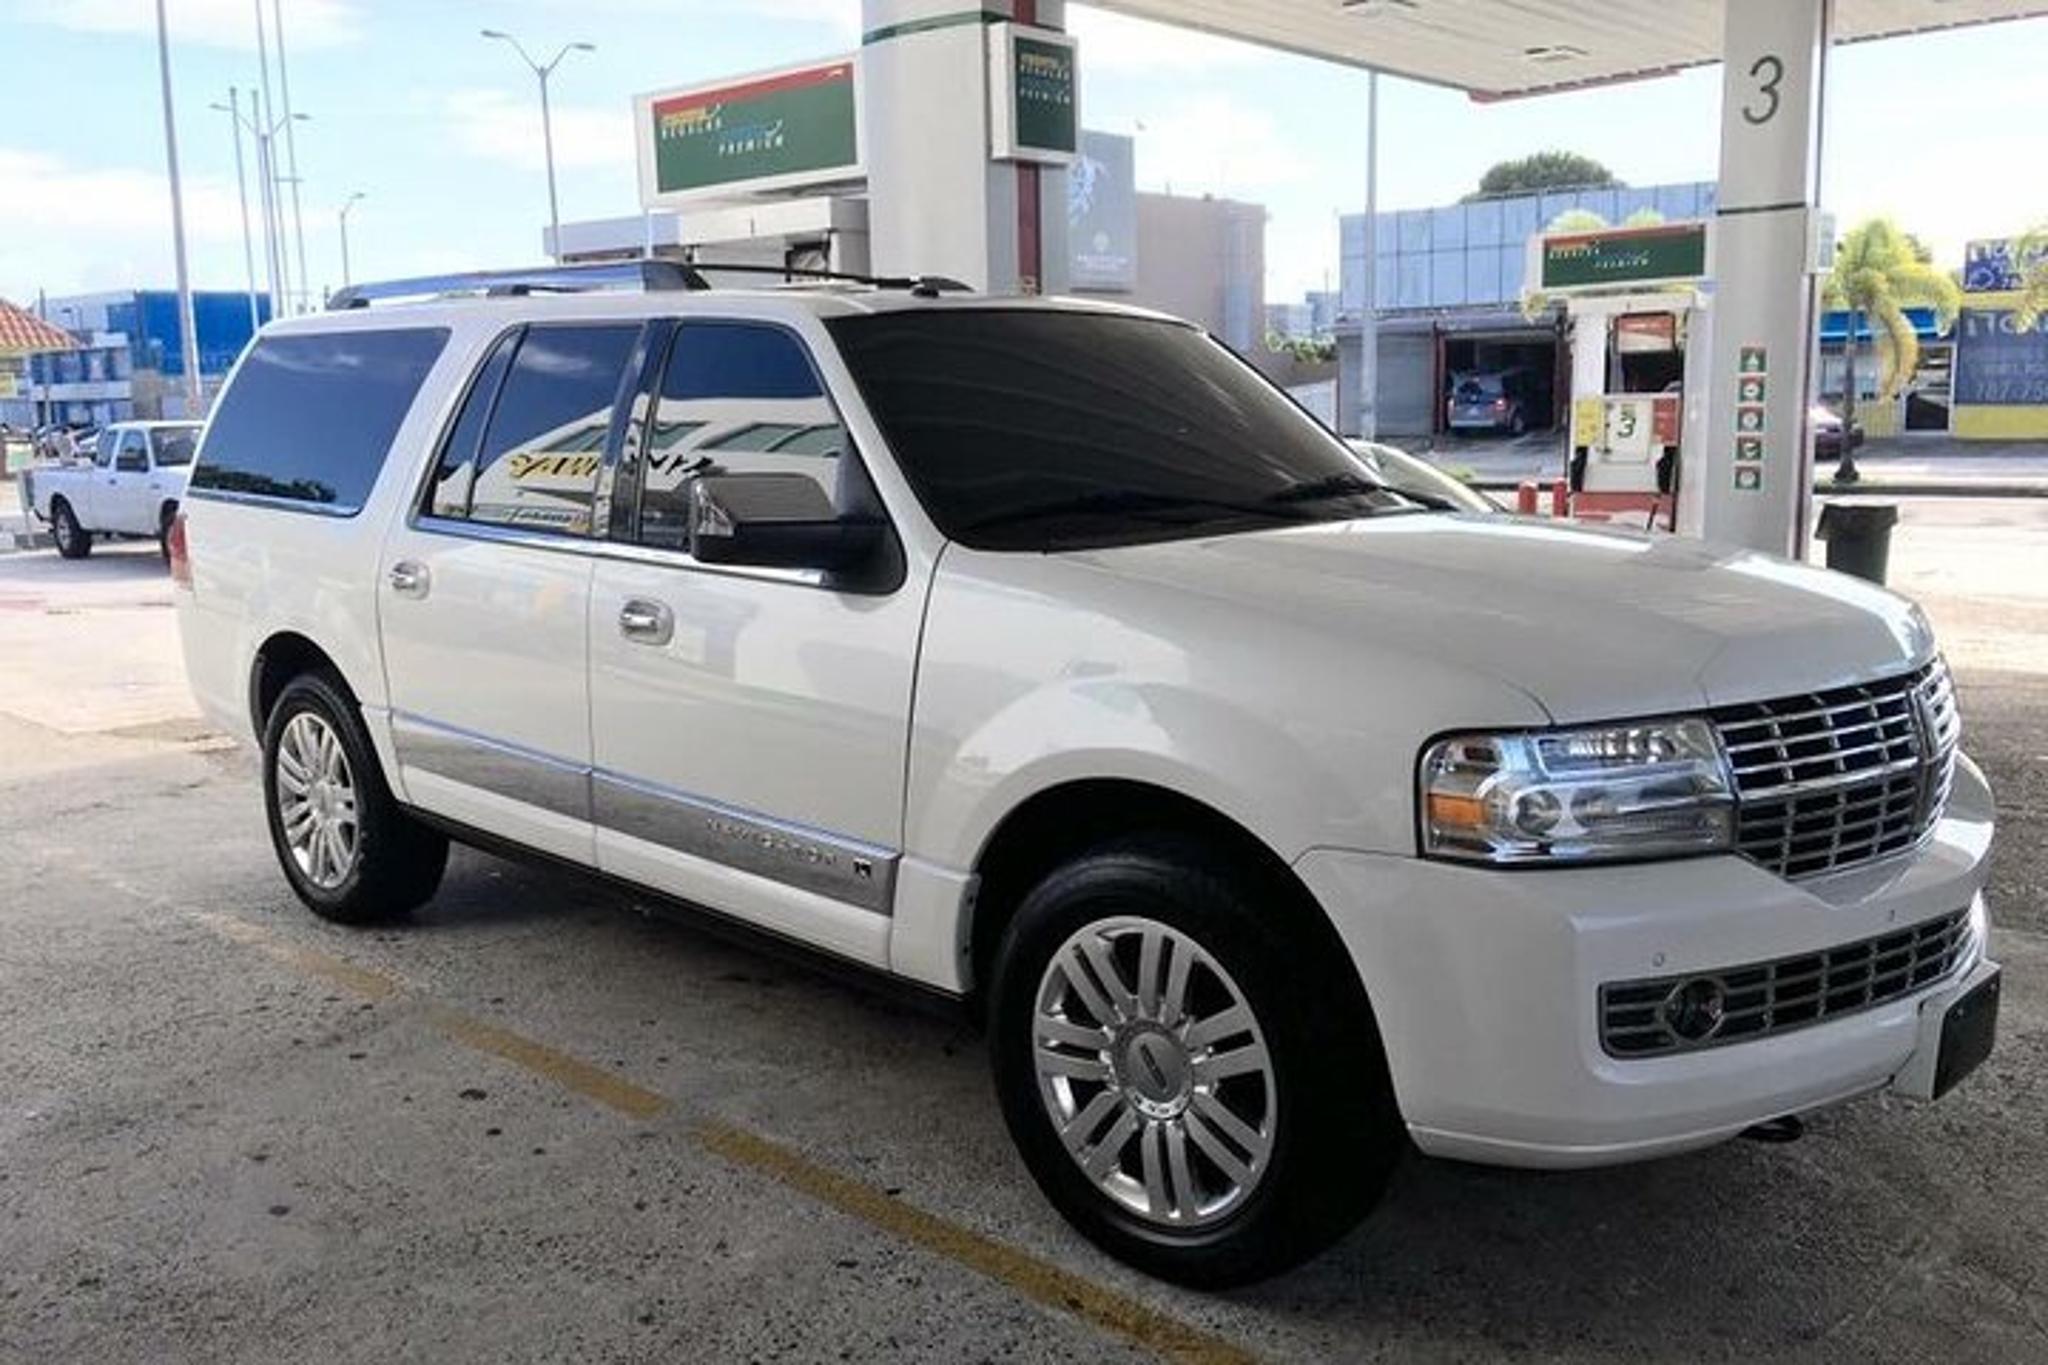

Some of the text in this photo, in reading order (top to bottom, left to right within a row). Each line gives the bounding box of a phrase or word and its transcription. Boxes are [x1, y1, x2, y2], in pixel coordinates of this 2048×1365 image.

[1742, 55, 1784, 125] 3
[718, 134, 783, 155] PREMIUM
[1617, 410, 1636, 438] 3
